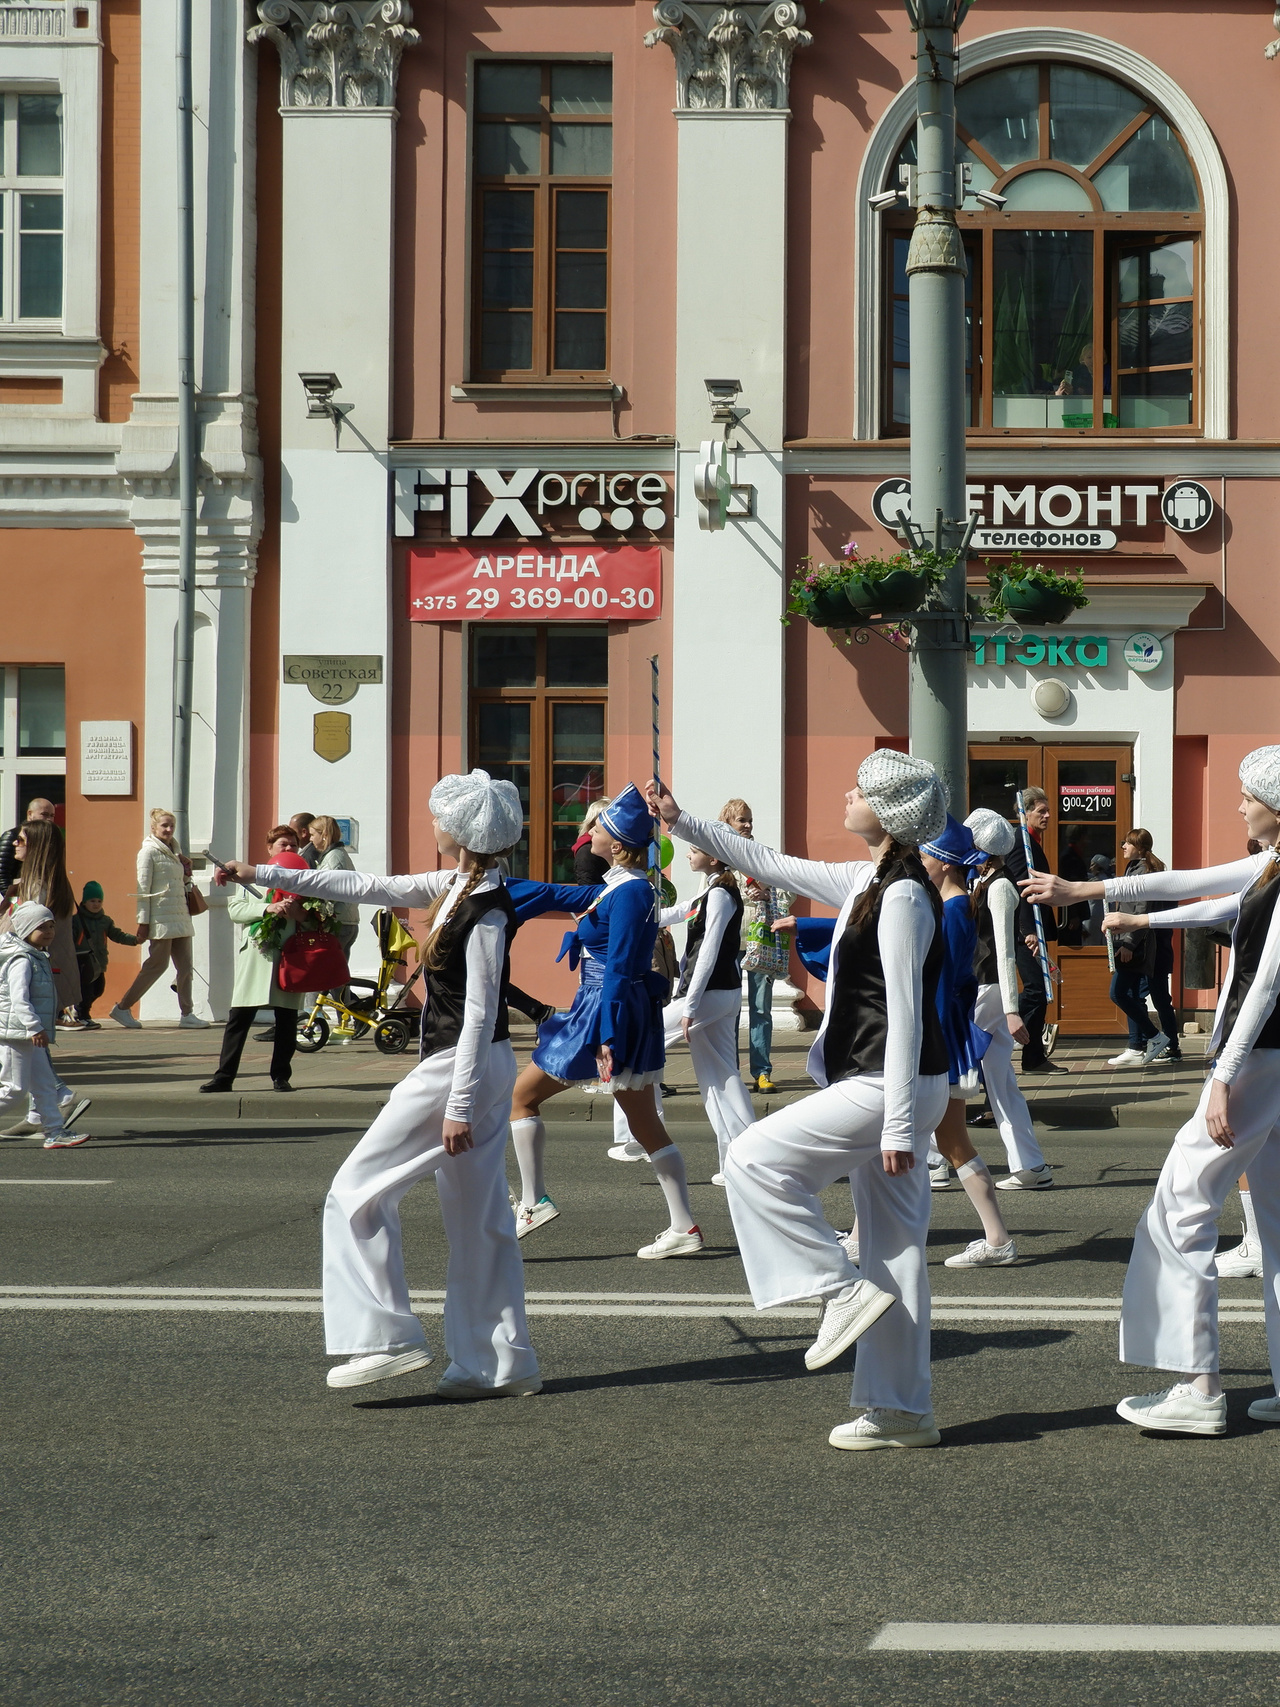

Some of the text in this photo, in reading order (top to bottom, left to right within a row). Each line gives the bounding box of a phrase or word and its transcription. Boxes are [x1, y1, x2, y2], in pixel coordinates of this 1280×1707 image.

[537, 473, 667, 515] price
[966, 484, 1158, 526] ЕМОНТ
[981, 531, 1102, 547] телефонов
[473, 555, 601, 582] АРЕНДА
[412, 587, 655, 610] +375 29 369-00-30
[288, 665, 377, 680] Советская
[322, 683, 343, 699] 22
[1086, 786, 1112, 795] работы
